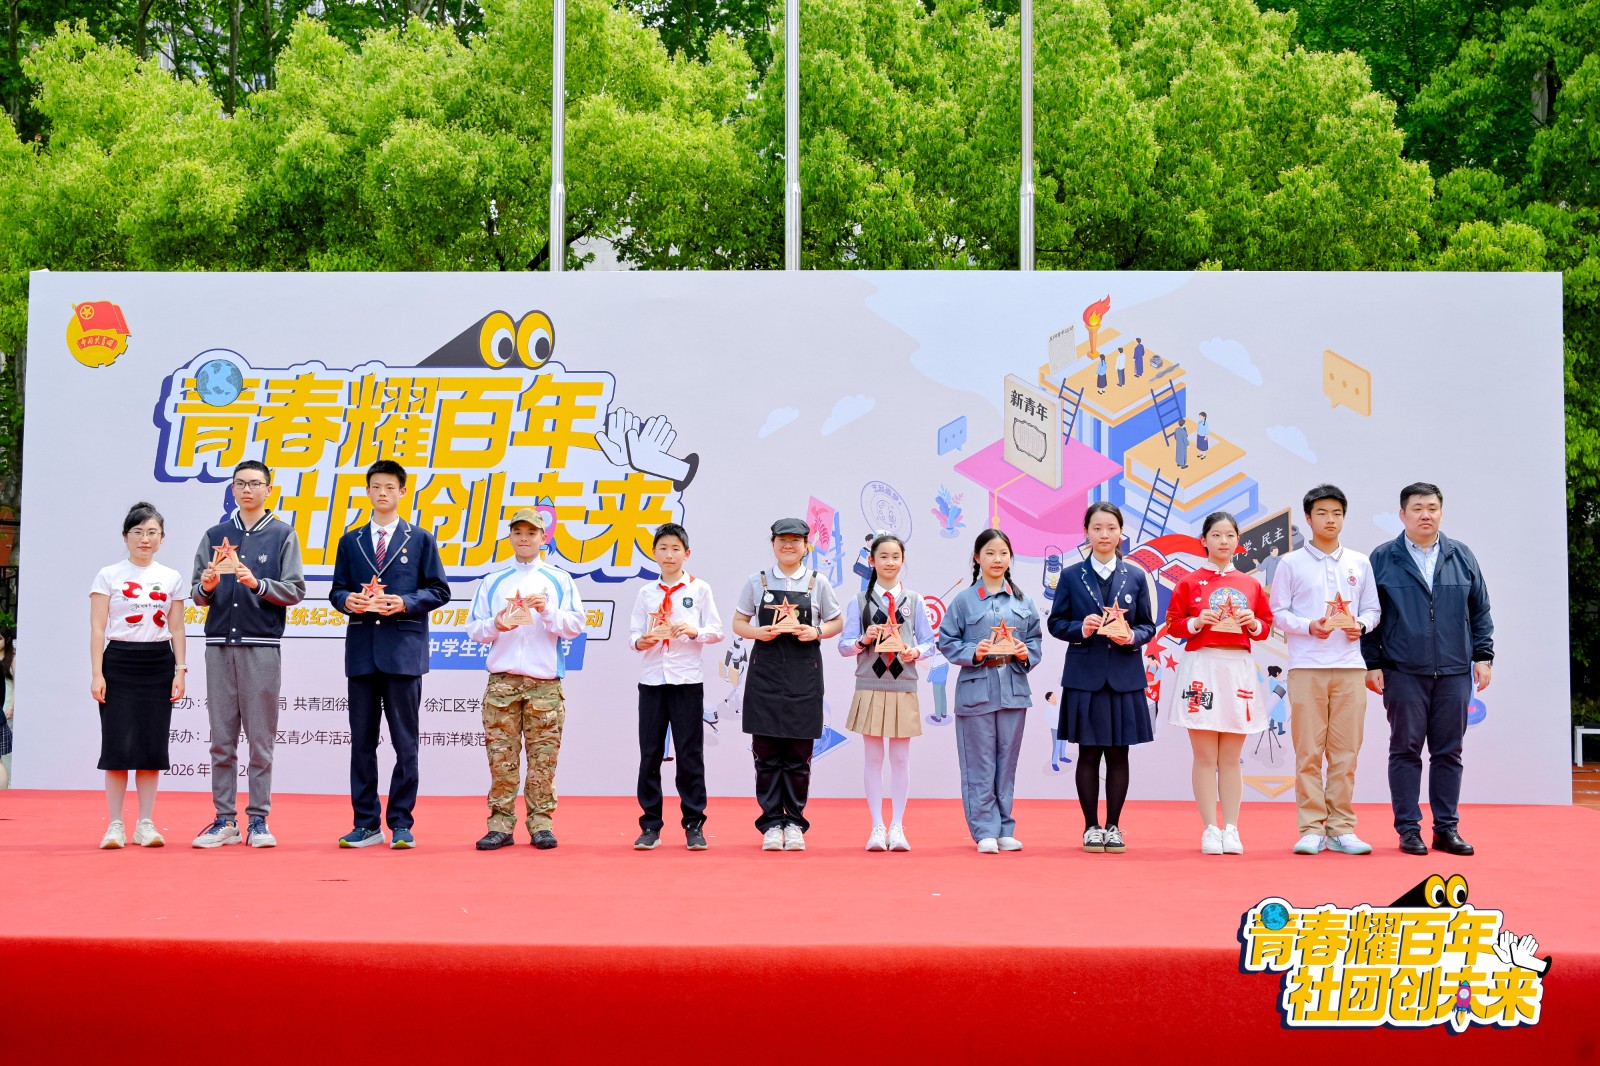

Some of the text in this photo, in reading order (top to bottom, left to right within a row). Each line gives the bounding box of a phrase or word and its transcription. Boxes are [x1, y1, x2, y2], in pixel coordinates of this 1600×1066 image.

[173, 371, 605, 469] 青春耀百年
[1009, 389, 1048, 421] 新青年
[424, 697, 484, 713] 徐汇区学
